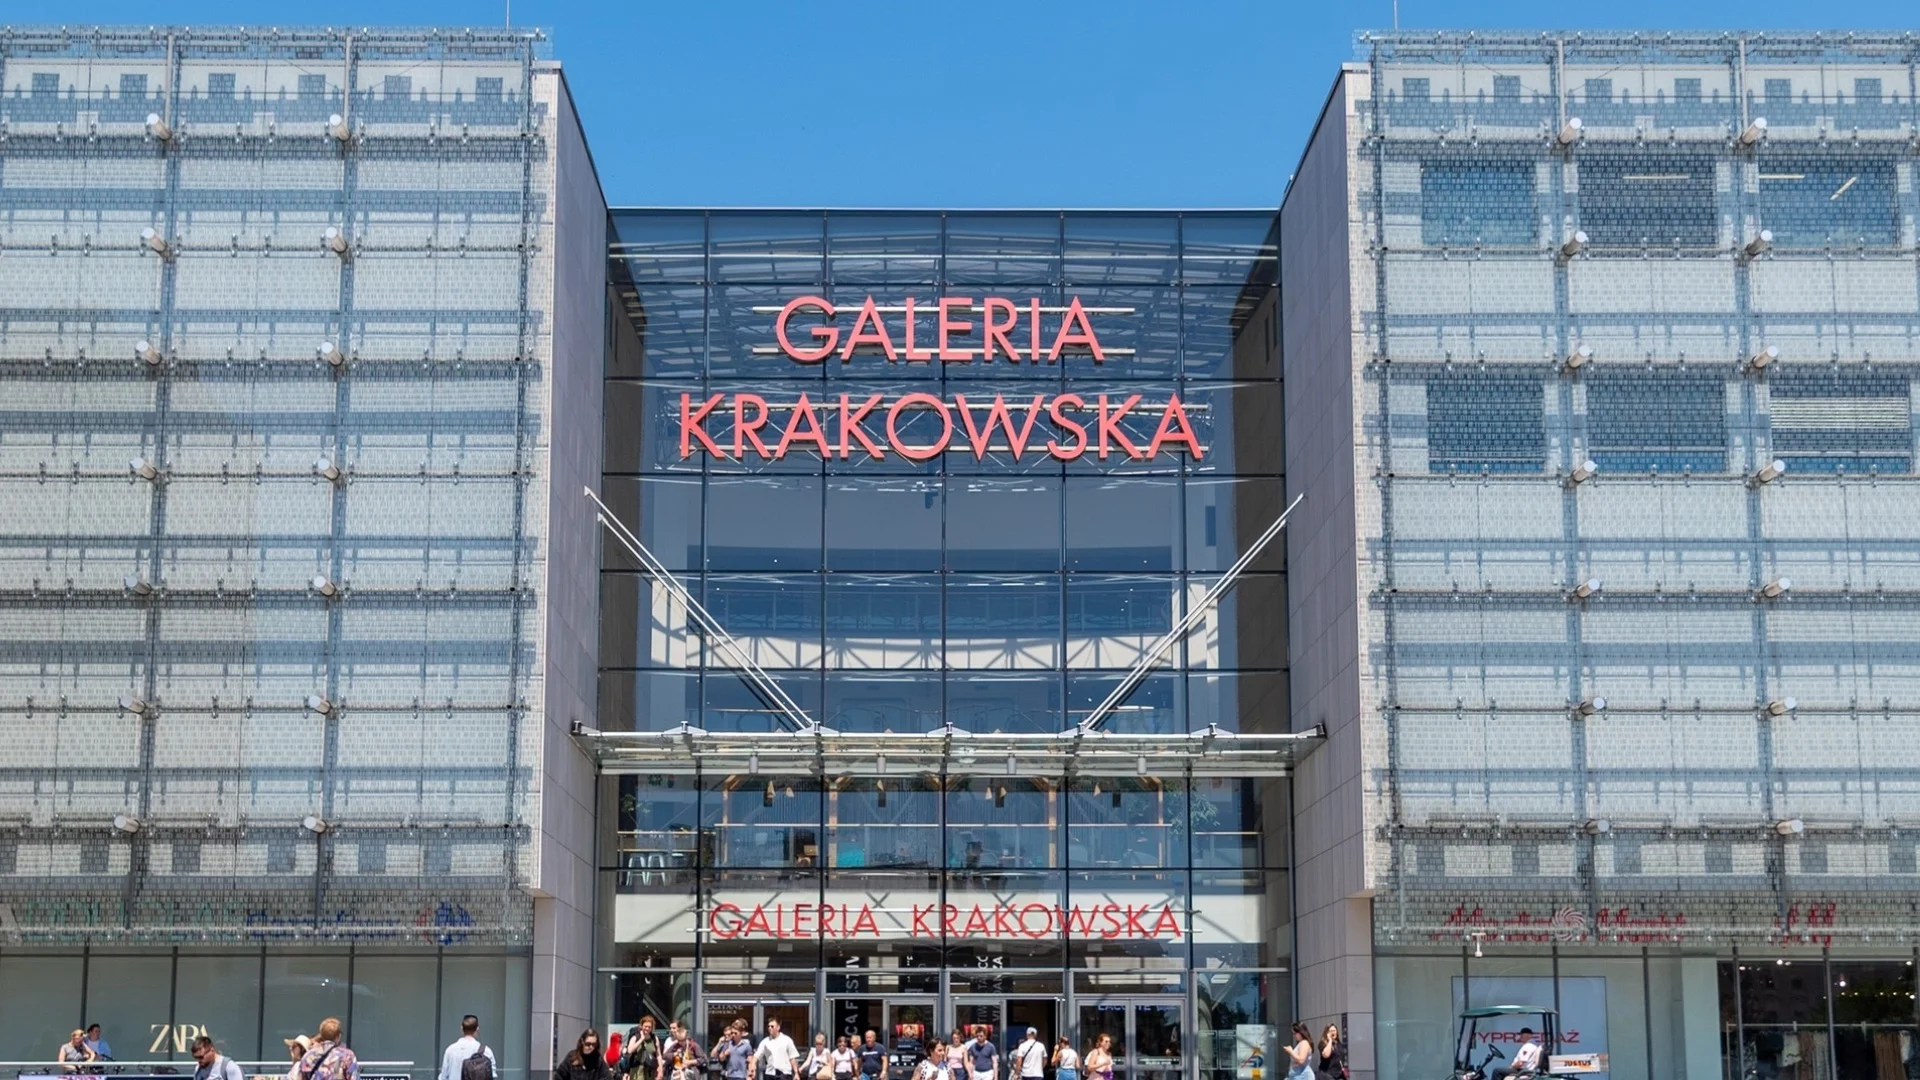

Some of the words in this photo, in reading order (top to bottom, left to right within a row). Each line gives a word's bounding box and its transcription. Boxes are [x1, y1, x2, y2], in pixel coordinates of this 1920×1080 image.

[775, 296, 1105, 362] GALERIA
[679, 393, 1203, 461] KRAKOWSKA
[709, 902, 880, 940] GALERIA
[912, 902, 1182, 940] KRAKOWSKA
